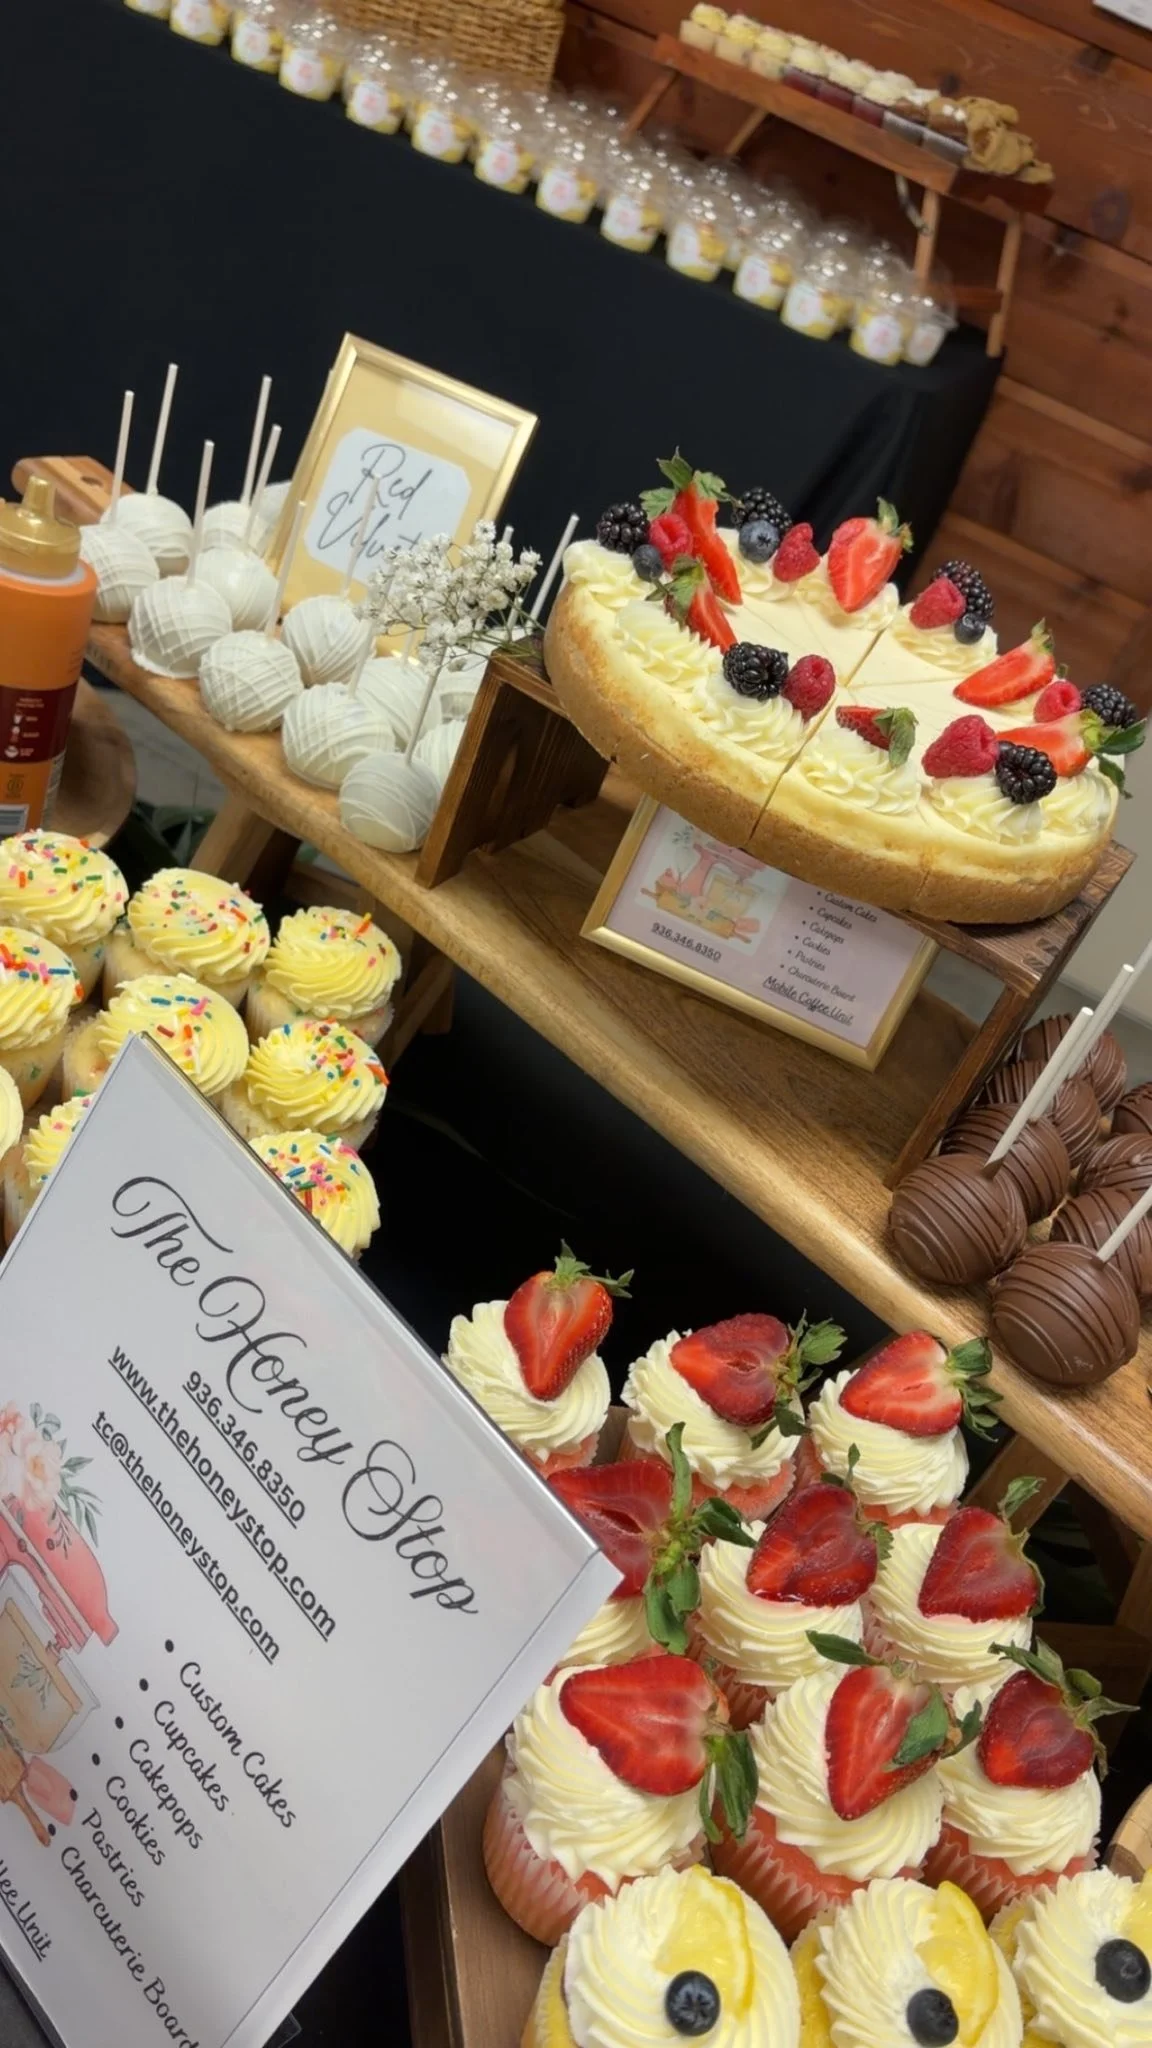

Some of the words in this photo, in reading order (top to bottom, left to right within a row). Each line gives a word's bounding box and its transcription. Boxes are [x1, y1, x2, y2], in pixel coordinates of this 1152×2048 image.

[349, 444, 433, 520] Red
[317, 491, 422, 558] Vlvt
[651, 922, 722, 962] 936.346.8350
[802, 936, 831, 956] Cookies
[809, 921, 844, 944] Cakepops
[817, 907, 852, 930] Cupcakes
[854, 906, 878, 923] Cakes
[762, 975, 799, 1001] Mobile
[797, 991, 831, 1014] Coffee
[830, 1006, 854, 1026] Unit
[794, 950, 826, 971] Pastries
[111, 1176, 234, 1286] The
[196, 1276, 353, 1465] Honey
[342, 1440, 479, 1614] Stop
[183, 1371, 306, 1527] 936.346.8350
[108, 1346, 336, 1641] www.thehoneystop.com
[92, 1411, 280, 1664] tc@thehoneystop.com
[154, 1701, 229, 1812] Cupcakes
[180, 1662, 243, 1756] Custom
[243, 1751, 296, 1828] Cakes
[106, 1776, 166, 1866] Cookies
[129, 1739, 203, 1850] Cakepops
[82, 1808, 145, 1907] Pastries
[17, 1901, 52, 1961] Unit
[61, 1846, 146, 1982] Charcuterie
